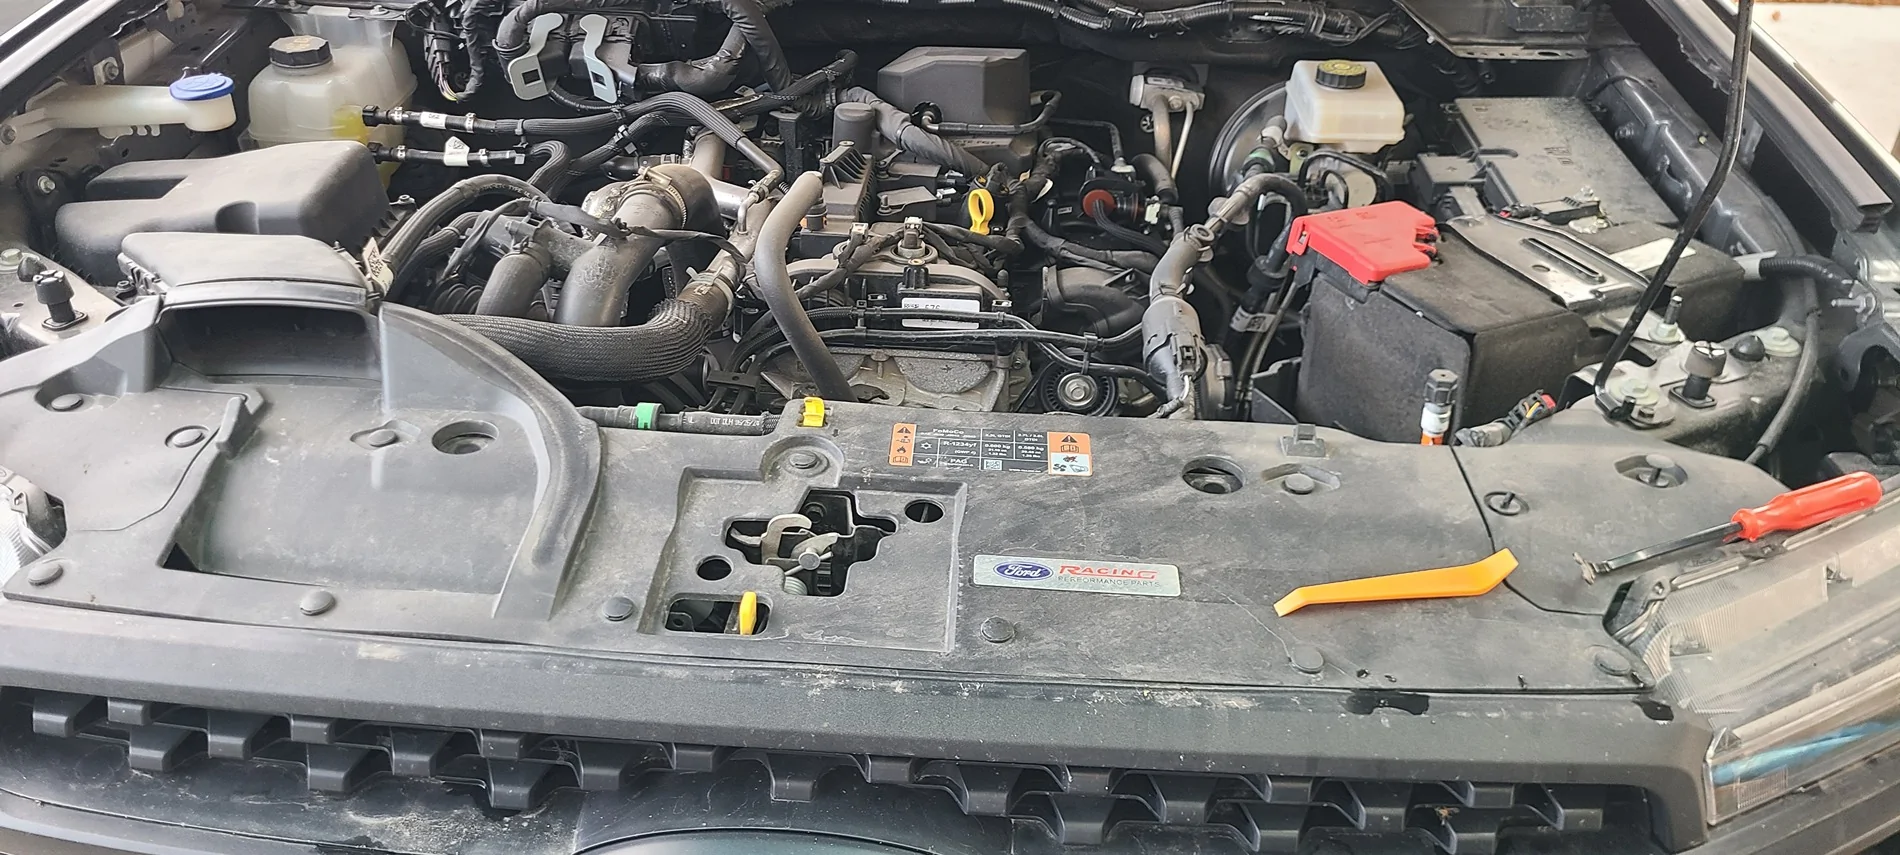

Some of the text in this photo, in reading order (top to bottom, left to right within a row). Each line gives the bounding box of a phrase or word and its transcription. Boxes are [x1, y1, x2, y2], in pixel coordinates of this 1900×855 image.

[943, 440, 977, 448] R-1234yf
[1003, 563, 1158, 580] Ford RACING
[1057, 576, 1160, 588] PERFORMANCE PARTS
